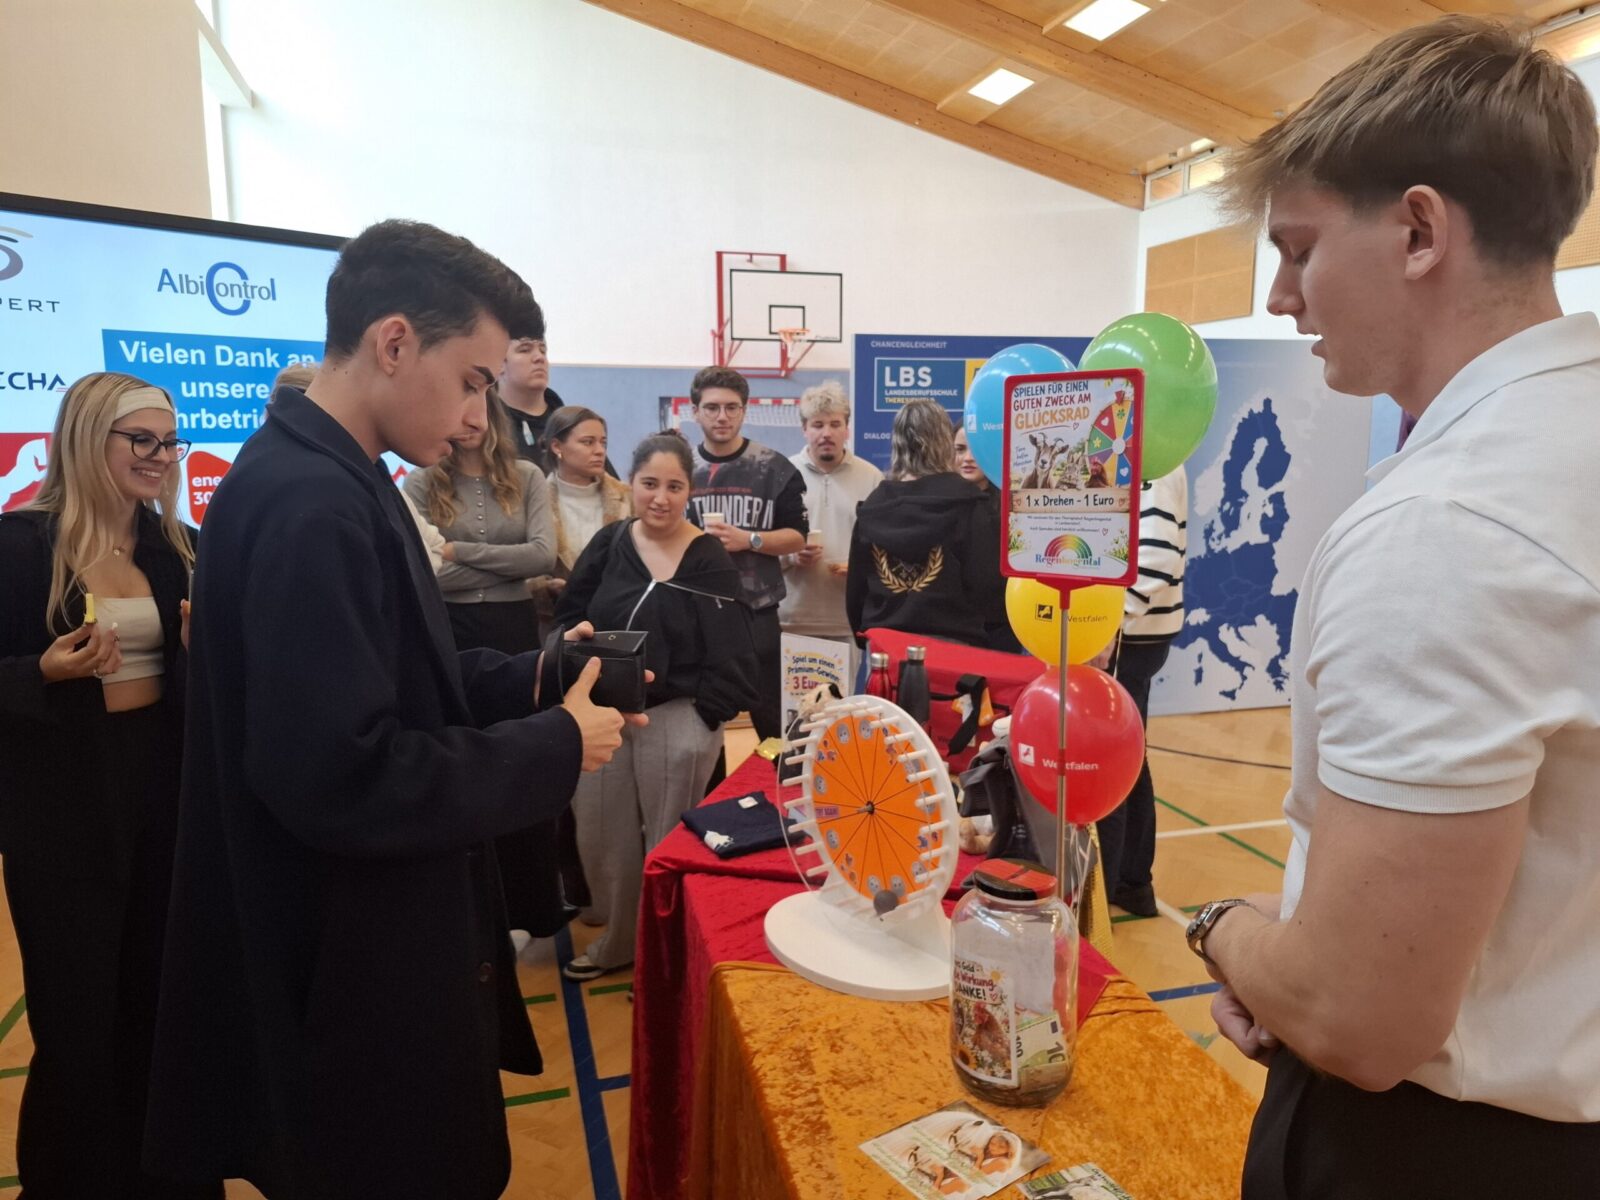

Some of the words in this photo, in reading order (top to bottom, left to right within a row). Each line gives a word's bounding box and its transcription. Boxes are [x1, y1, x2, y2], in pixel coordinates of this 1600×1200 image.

[157, 261, 277, 316] AlbiControl
[0, 297, 60, 313] ERT
[870, 340, 947, 349] CHANCENGLEICHHEIT
[119, 340, 206, 365] Vielen
[214, 345, 280, 368] Dank
[884, 366, 932, 388] LBS
[181, 381, 270, 399] unsere
[1014, 384, 1046, 398] SPIELEN
[1048, 382, 1063, 395] FÜR
[1065, 380, 1089, 392] EINEN
[1013, 396, 1042, 412] GUTEN
[1044, 394, 1075, 408] ZWECK
[1077, 392, 1092, 404] AM
[1014, 406, 1090, 430] GLÜCKSRAD
[863, 432, 891, 440] DIALOG
[1026, 495, 1031, 507] 1
[1043, 494, 1074, 507] Drehen
[1084, 493, 1089, 507] 1
[1093, 494, 1115, 507] Euro
[792, 676, 800, 690] 3
[1042, 757, 1099, 771] Wetfalen
